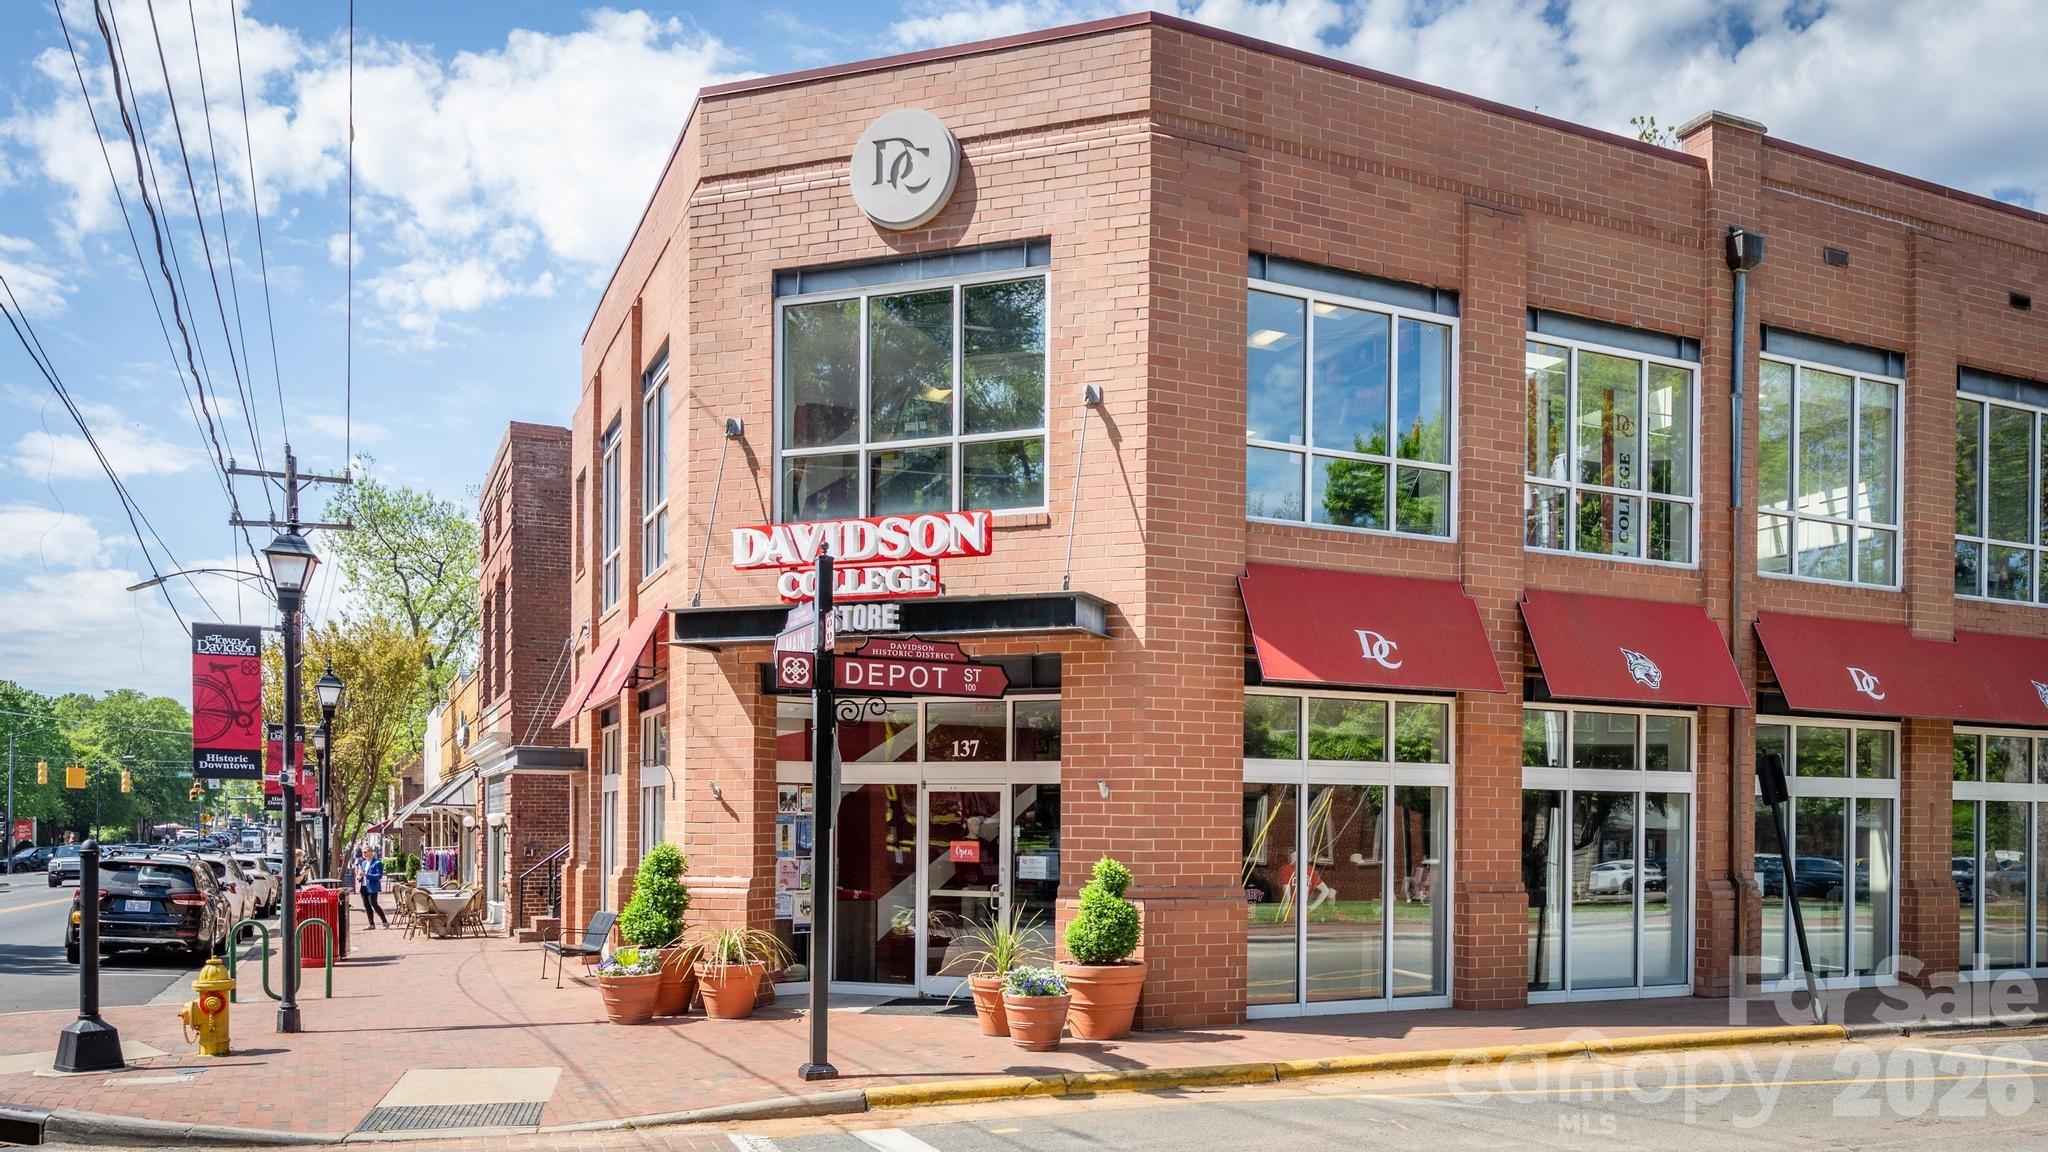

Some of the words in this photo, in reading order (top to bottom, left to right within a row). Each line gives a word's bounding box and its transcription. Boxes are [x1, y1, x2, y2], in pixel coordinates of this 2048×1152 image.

[1618, 453, 1630, 544] COLLEGE
[731, 511, 988, 567] DAVIDSON
[778, 564, 937, 599] COLLEGE
[196, 639, 257, 653] Davidson
[212, 634, 239, 645] Town
[239, 638, 250, 648] of
[890, 643, 935, 652] DAVIDSON
[872, 649, 913, 658] HISTORIC
[916, 652, 955, 660] DISTRICT
[1353, 629, 1403, 669] DC
[845, 662, 948, 689] DEPOT
[963, 668, 982, 683] ST
[964, 683, 976, 692] 100
[1846, 667, 1886, 700] DC
[951, 740, 980, 757] 137
[206, 753, 249, 763] Historic
[199, 761, 256, 770] Downtown
[955, 846, 974, 858] Open
